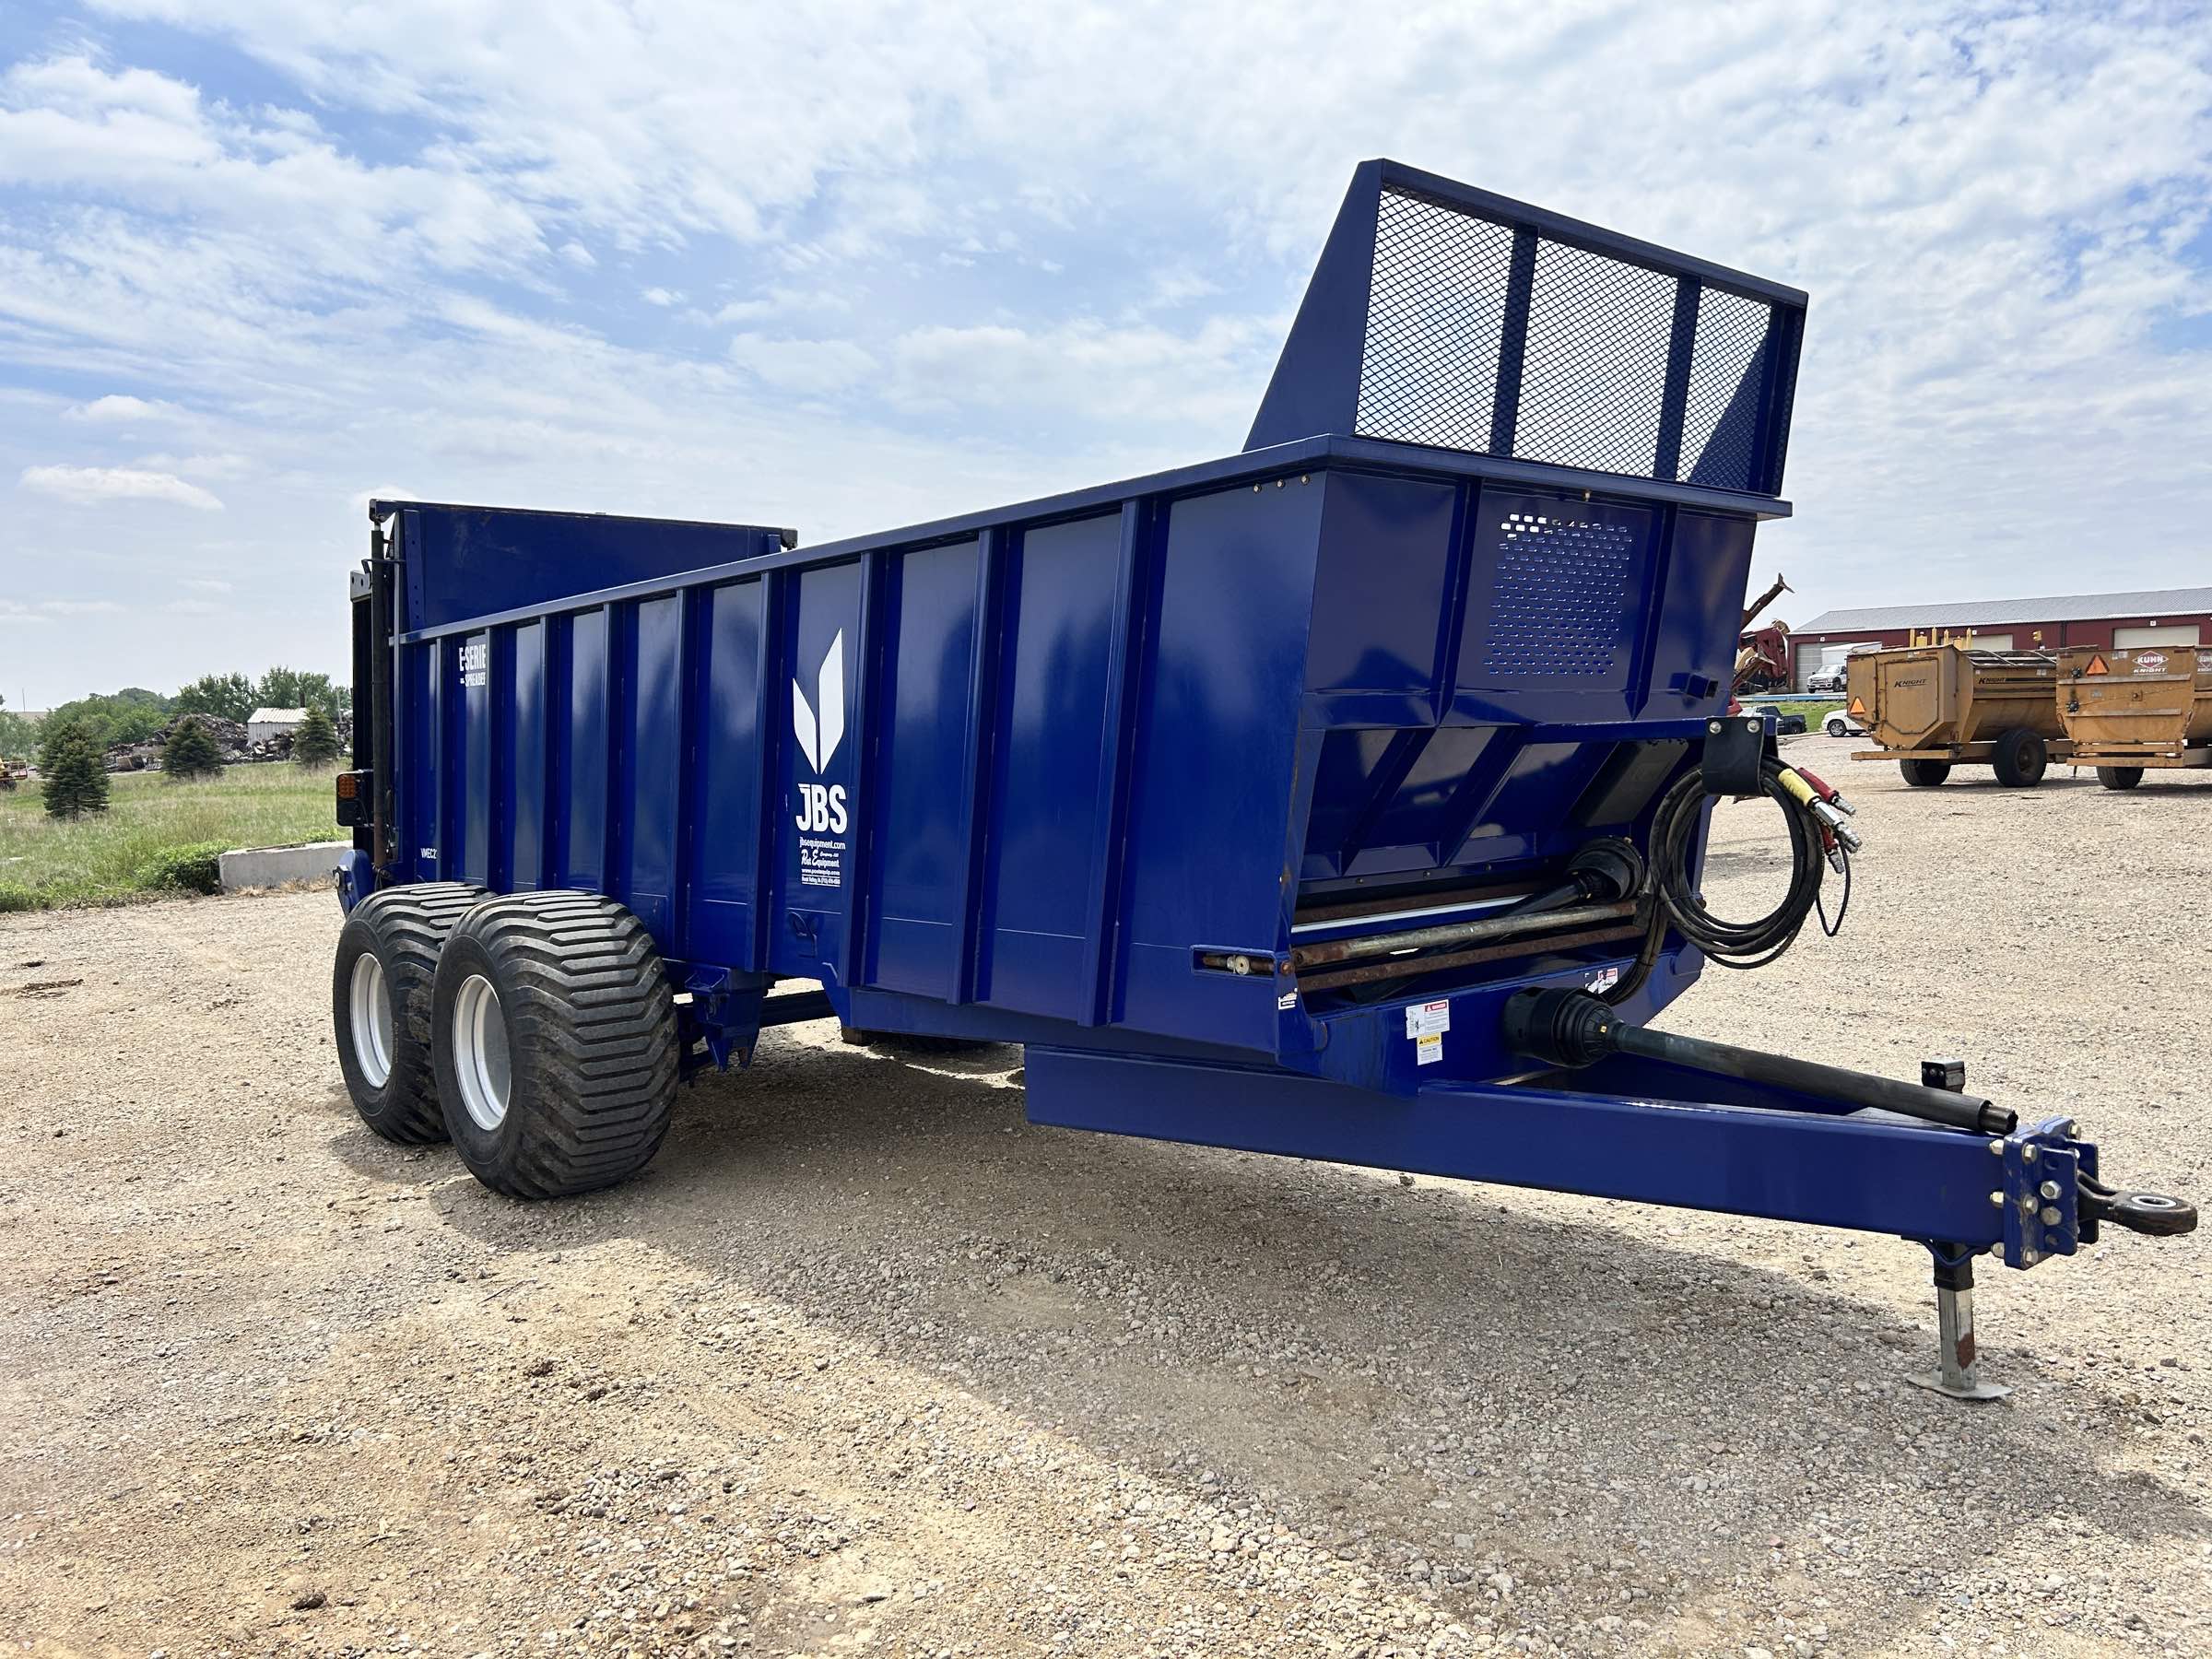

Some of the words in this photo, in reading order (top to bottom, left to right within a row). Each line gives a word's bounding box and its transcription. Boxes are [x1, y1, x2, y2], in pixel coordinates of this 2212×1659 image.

[2137, 655, 2163, 664] KUHN
[1894, 678, 1927, 688] KNIGHT
[795, 782, 848, 834] JBS
[799, 836, 846, 851] jbsequipment.com
[812, 849, 840, 868] Equipment
